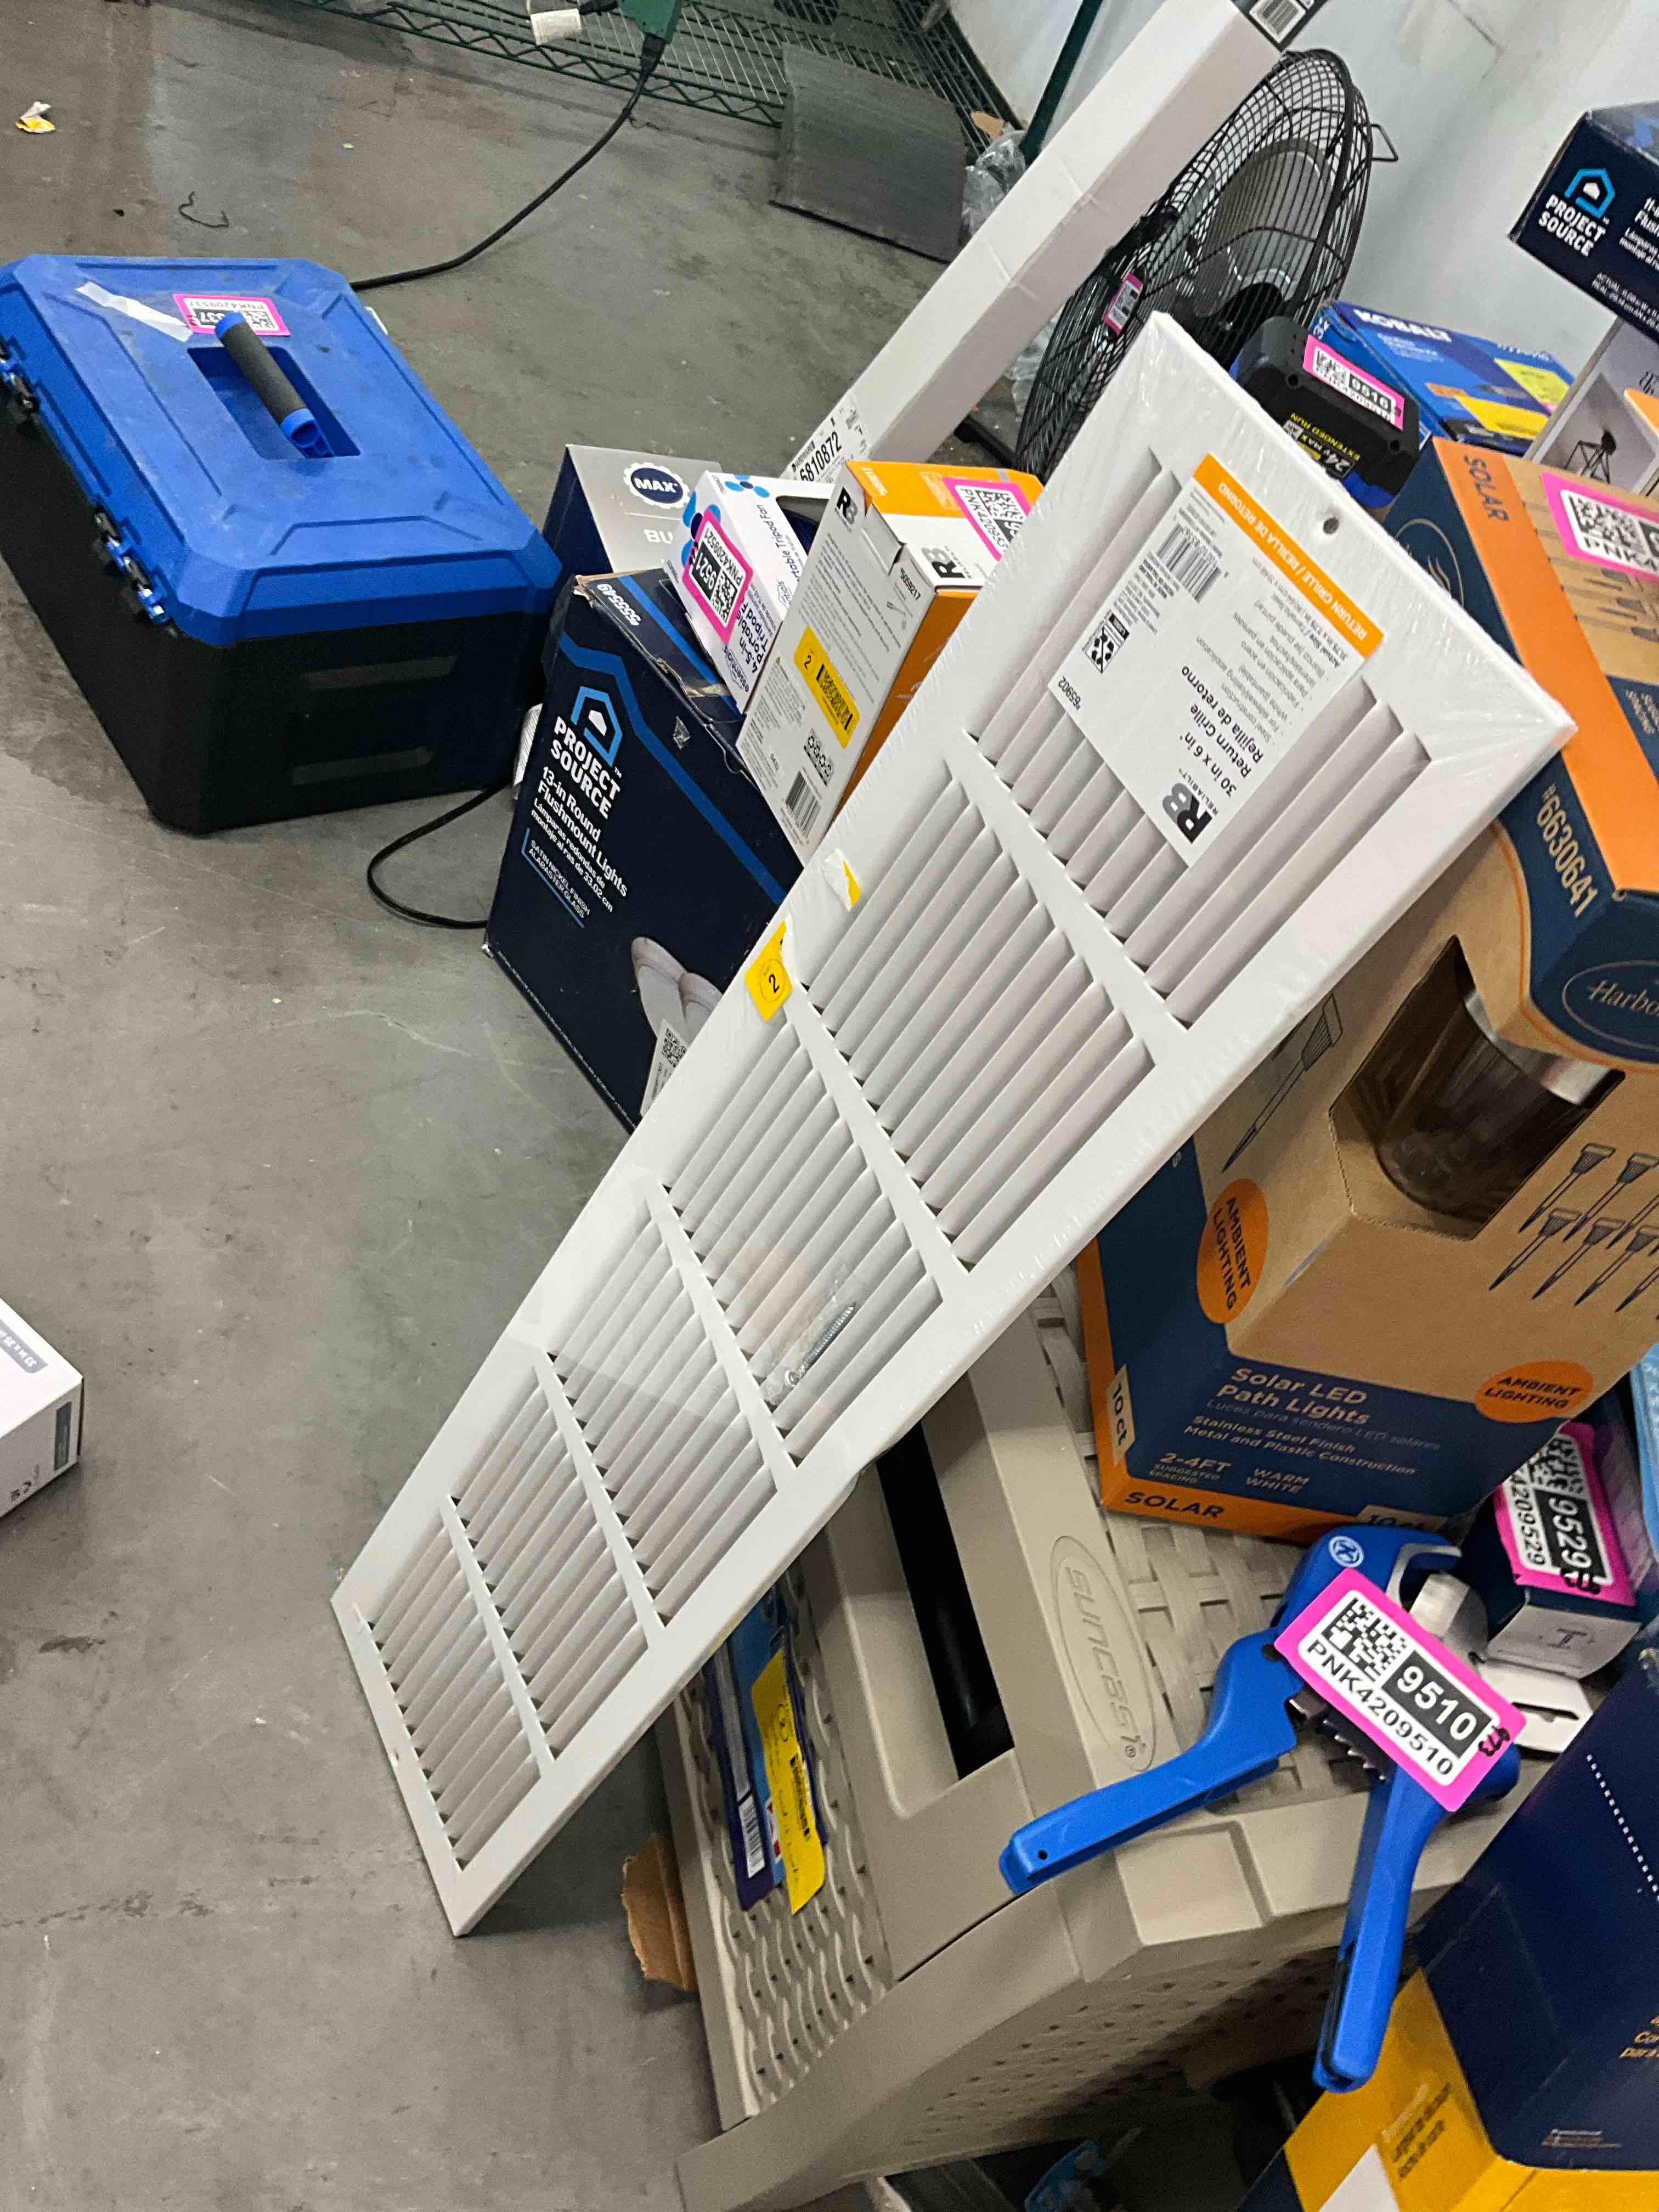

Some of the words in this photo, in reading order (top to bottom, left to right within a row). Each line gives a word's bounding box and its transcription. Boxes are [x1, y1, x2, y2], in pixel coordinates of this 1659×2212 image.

[1538, 210, 1594, 257] SOURCE
[1545, 193, 1607, 245] PROJECT
[635, 478, 676, 493] MAX
[1217, 482, 1256, 523] RETORNO
[1464, 455, 1510, 523] SOLAR
[766, 520, 786, 548] Tripod
[1252, 520, 1268, 536] DE
[704, 529, 743, 584] PNK4209521
[782, 549, 801, 577] rtable
[1302, 572, 1333, 603] GRILLE
[734, 612, 764, 659] Portable
[745, 610, 770, 650] Tripod
[1330, 601, 1367, 639] RETURN
[737, 637, 758, 671] 4.5-in
[801, 655, 814, 669] 2
[1179, 664, 1220, 708] retorno
[1187, 703, 1218, 736] Grille
[1214, 706, 1233, 725] de
[554, 717, 619, 799] PROJECT
[1191, 744, 1204, 757] 6
[1202, 753, 1213, 764] x
[1213, 733, 1252, 776] Return
[1228, 723, 1265, 761] Rejilla
[551, 740, 611, 818] SOURCE
[1207, 763, 1221, 776] in
[1216, 773, 1238, 795] 30
[543, 768, 566, 799] 13-in
[566, 795, 600, 840] Round
[534, 799, 565, 839] Lámparas
[567, 839, 594, 874] redondas
[595, 873, 605, 888] de
[538, 781, 597, 857] Flushmount
[596, 853, 628, 896] Lights
[1537, 783, 1598, 918] #6630641
[532, 810, 556, 841] montaje
[556, 838, 564, 849] al
[563, 848, 576, 864] ras
[575, 863, 585, 874] de
[584, 873, 602, 896] 33.02
[602, 897, 612, 911] cm
[768, 974, 780, 994] 2
[1212, 1212, 1237, 1311] LIGHTING
[1224, 1196, 1252, 1289] AMBIENT
[1113, 1383, 1122, 1415] 10
[1217, 1384, 1280, 1407] Path
[1285, 1397, 1370, 1425] Lights
[1231, 1368, 1305, 1393] Solar
[1308, 1383, 1367, 1406] LED
[1483, 1387, 1569, 1410] LIGHTING
[1497, 1375, 1583, 1397] AMBIENT
[1116, 1418, 1126, 1445] ct
[1183, 1425, 1228, 1441] Metal
[1228, 1435, 1261, 1447] and
[1263, 1440, 1314, 1457] Plastic
[1319, 1452, 1416, 1475] Construction
[1192, 1415, 1263, 1436] Stainless
[1266, 1430, 1307, 1444] Steel
[1309, 1437, 1355, 1453] Finish
[1160, 1452, 1232, 1472] 2-4FT
[1253, 1468, 1310, 1485] WARM
[1245, 1477, 1302, 1494] WHITE
[1125, 1491, 1226, 1520] SOLAR
[1511, 1476, 1546, 1566] 4209529
[1549, 1498, 1592, 1570] 9529
[1307, 1644, 1453, 1777] PNK4209510
[1397, 1666, 1477, 1741] 9510
